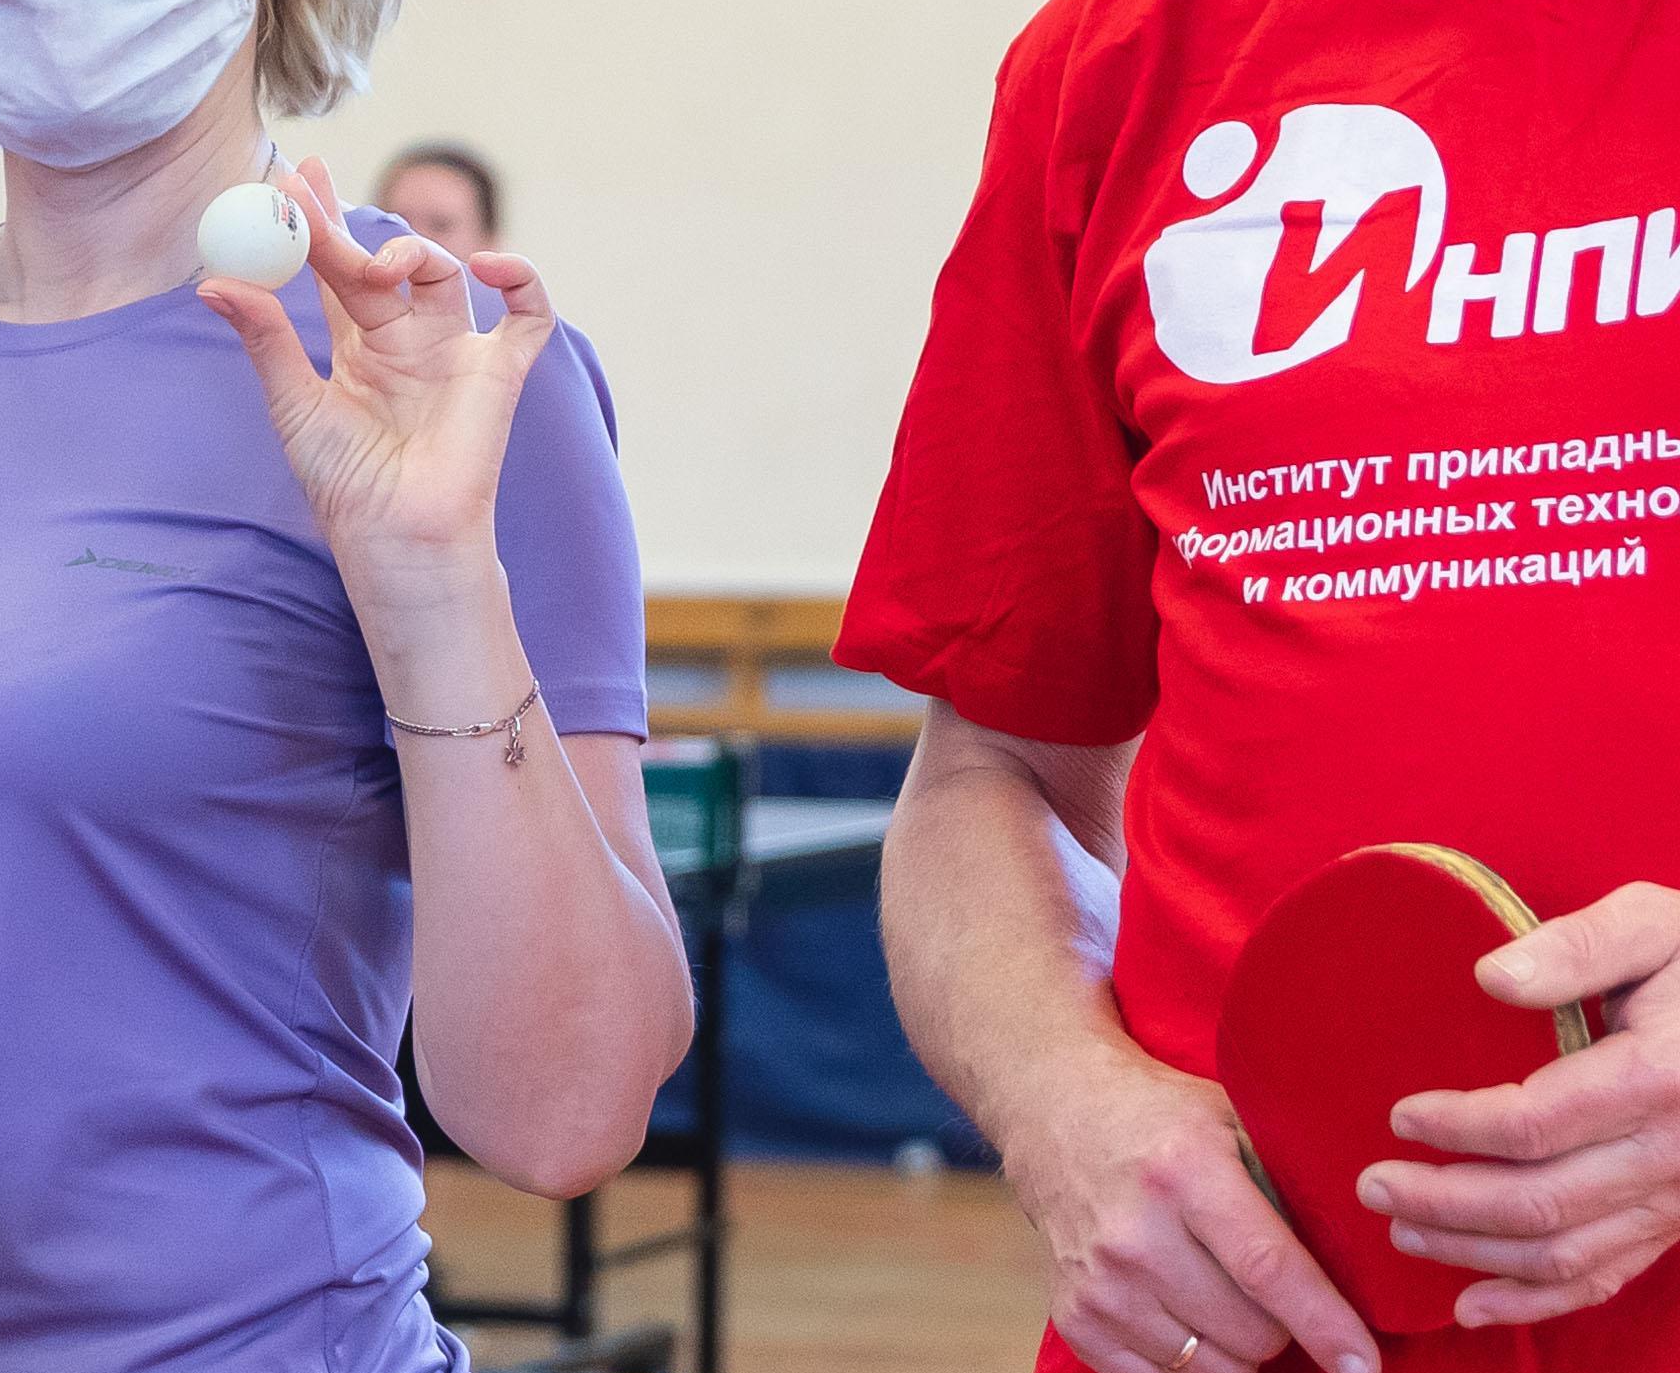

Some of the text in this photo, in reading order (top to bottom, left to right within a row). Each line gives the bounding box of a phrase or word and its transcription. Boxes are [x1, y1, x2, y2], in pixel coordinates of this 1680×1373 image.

[1201, 454, 1393, 510] Институт
[1172, 500, 1517, 569] формационных
[1241, 535, 1647, 605] и коммуникаций
